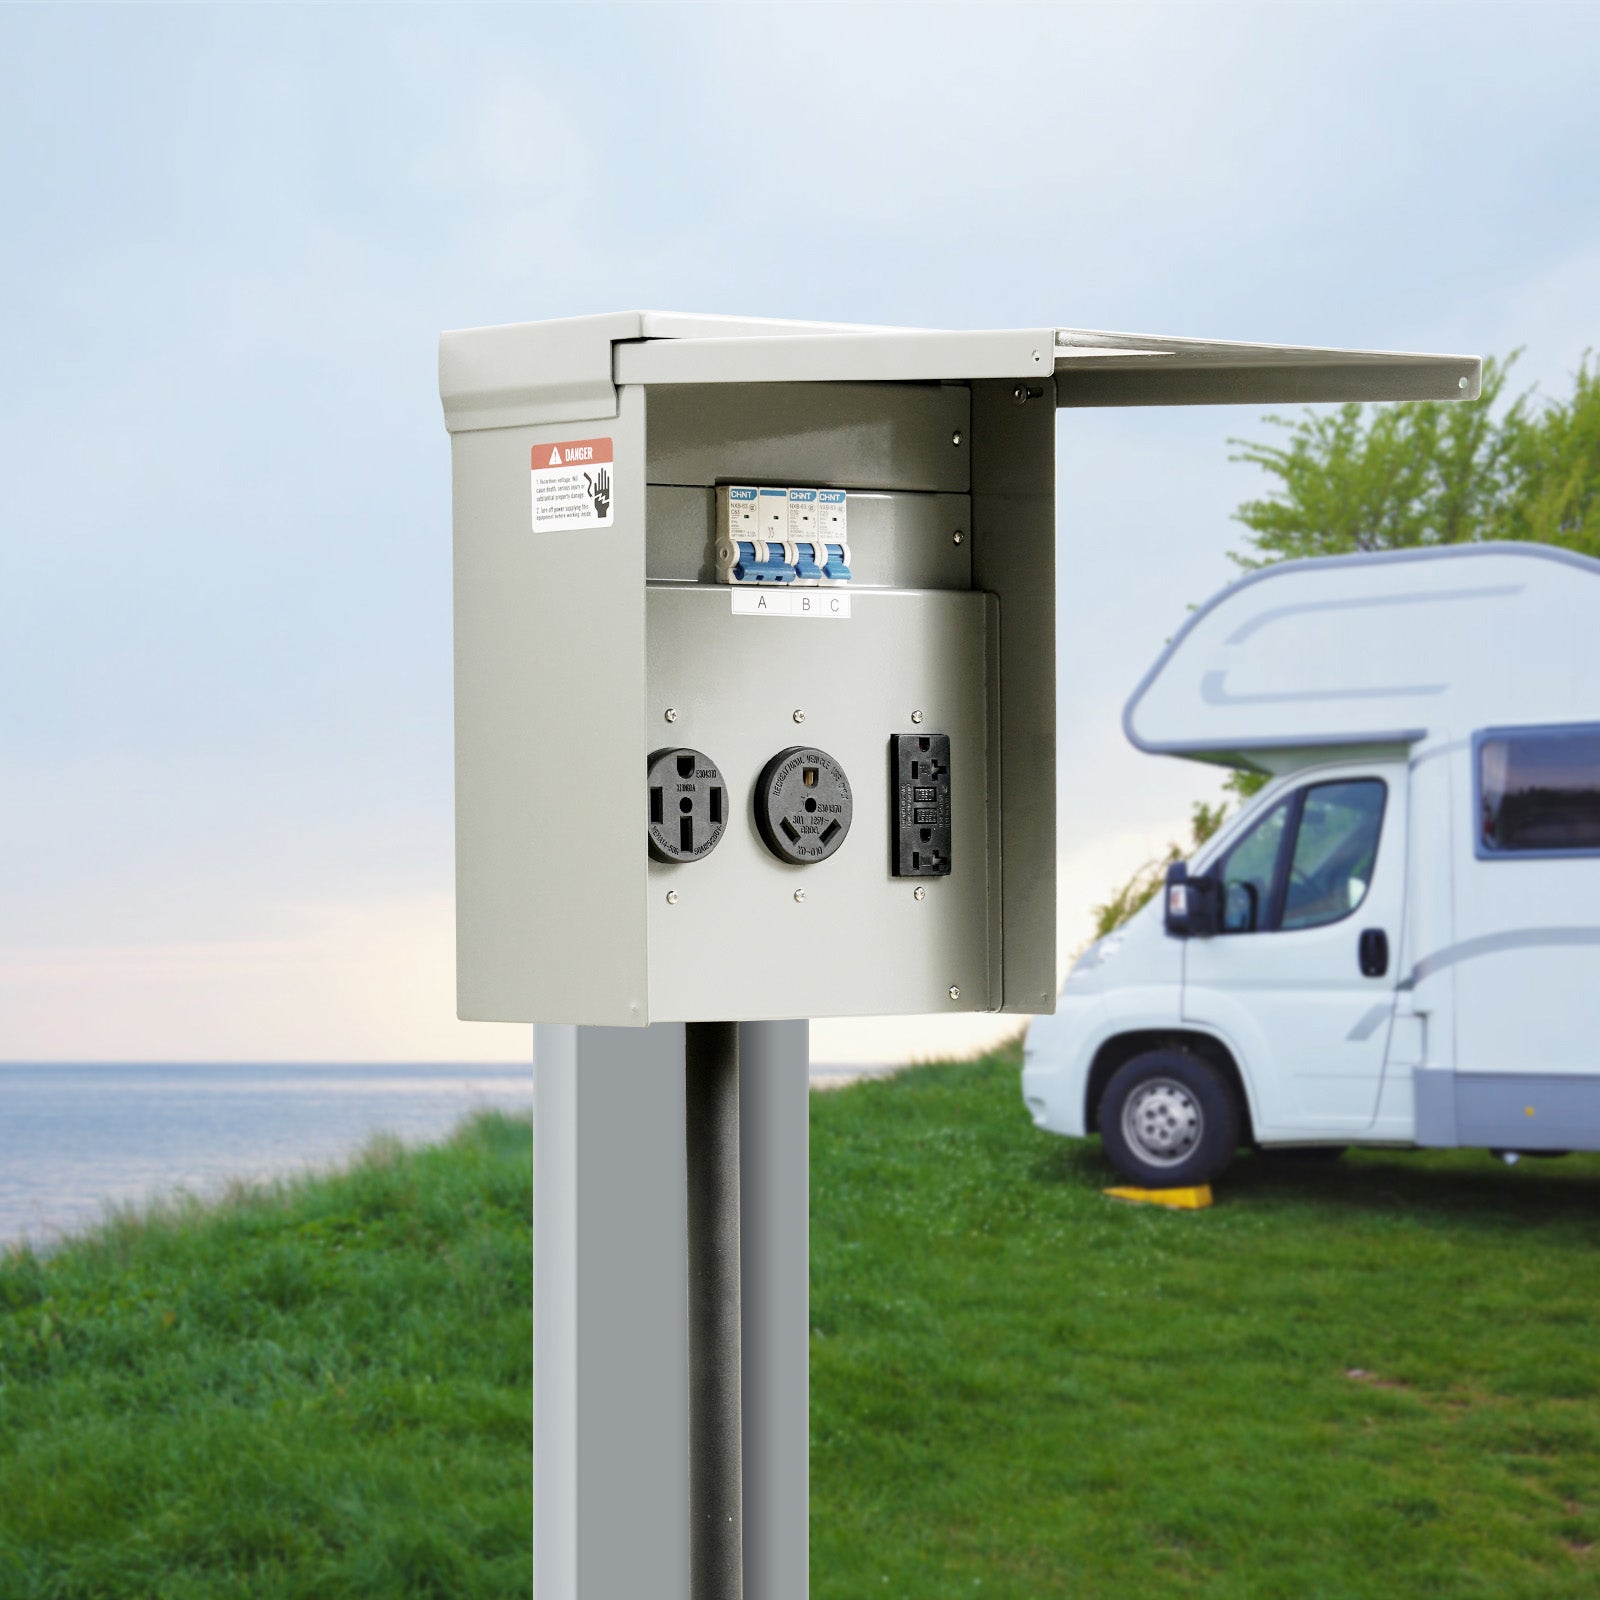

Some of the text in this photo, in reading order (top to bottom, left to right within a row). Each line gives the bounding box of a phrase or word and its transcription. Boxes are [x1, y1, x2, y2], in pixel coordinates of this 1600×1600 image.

[564, 446, 593, 462] DANGER
[758, 595, 840, 612] A B C
